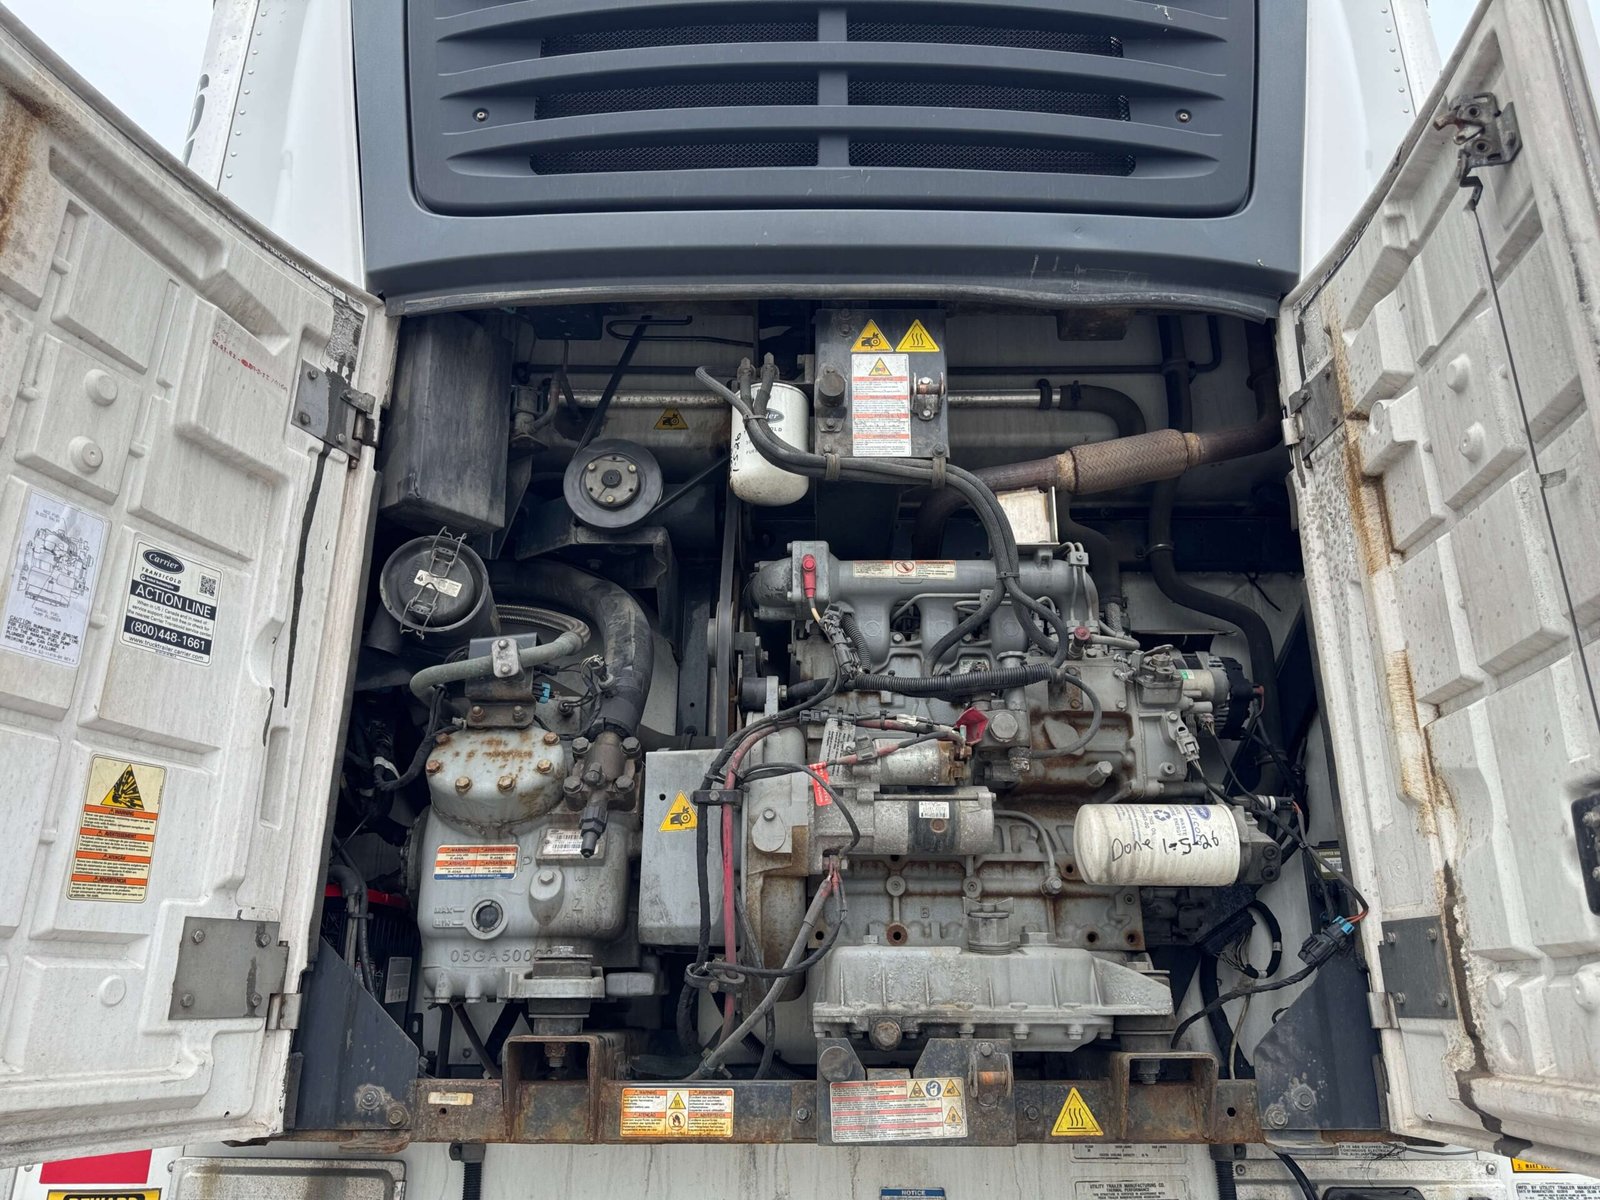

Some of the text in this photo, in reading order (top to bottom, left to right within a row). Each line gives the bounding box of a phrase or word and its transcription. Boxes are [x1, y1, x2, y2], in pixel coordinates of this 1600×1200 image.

[149, 553, 179, 569] Carrier
[141, 567, 182, 585] TRANSICOLD
[135, 584, 212, 618] ACTION LINE
[1112, 838, 1153, 862] Done
